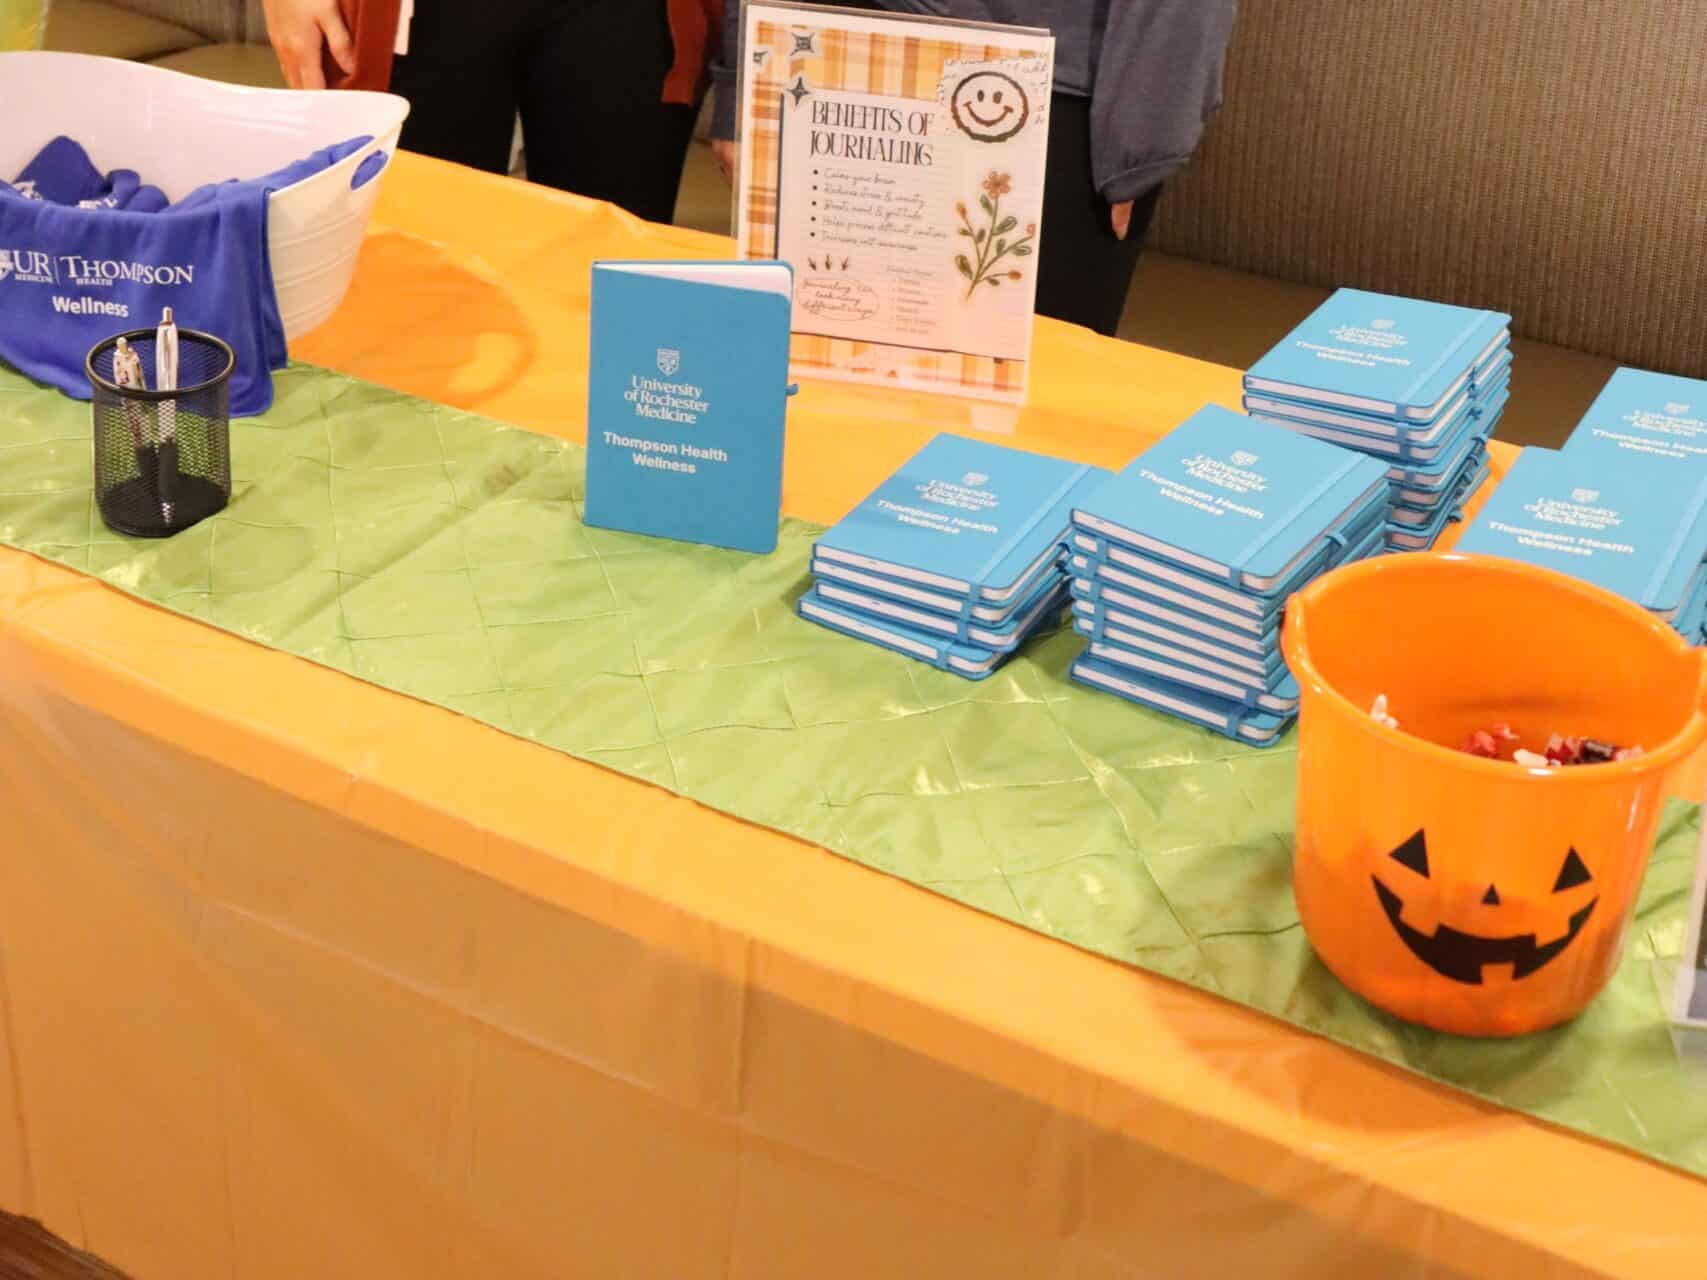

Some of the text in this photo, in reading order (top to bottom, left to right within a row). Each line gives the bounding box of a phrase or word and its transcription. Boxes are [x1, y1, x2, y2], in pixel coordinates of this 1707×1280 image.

[812, 100, 935, 136] BENEFITS OF
[810, 130, 934, 167] JOURNALING
[13, 250, 50, 275] UR
[60, 255, 194, 285] THOMPSON
[76, 277, 113, 287] HEALTH
[52, 296, 129, 317] Wellness
[1296, 340, 1410, 366] Thompson Health
[1316, 351, 1376, 367] Wellness
[632, 375, 703, 399] University
[624, 389, 710, 412] of Rochester
[636, 403, 697, 424] Medicine
[603, 431, 729, 462] Thompson Health
[1592, 428, 1670, 448] Thompson
[1618, 442, 1686, 458] Wellness
[632, 452, 697, 474] Wellness
[1140, 469, 1264, 519] Thompson Health
[1160, 487, 1224, 515] Wellness
[878, 499, 998, 533] Thompson Health
[898, 513, 960, 534] Wellness
[1489, 520, 1634, 553] Thompson Health
[1518, 536, 1592, 556] Wellness
